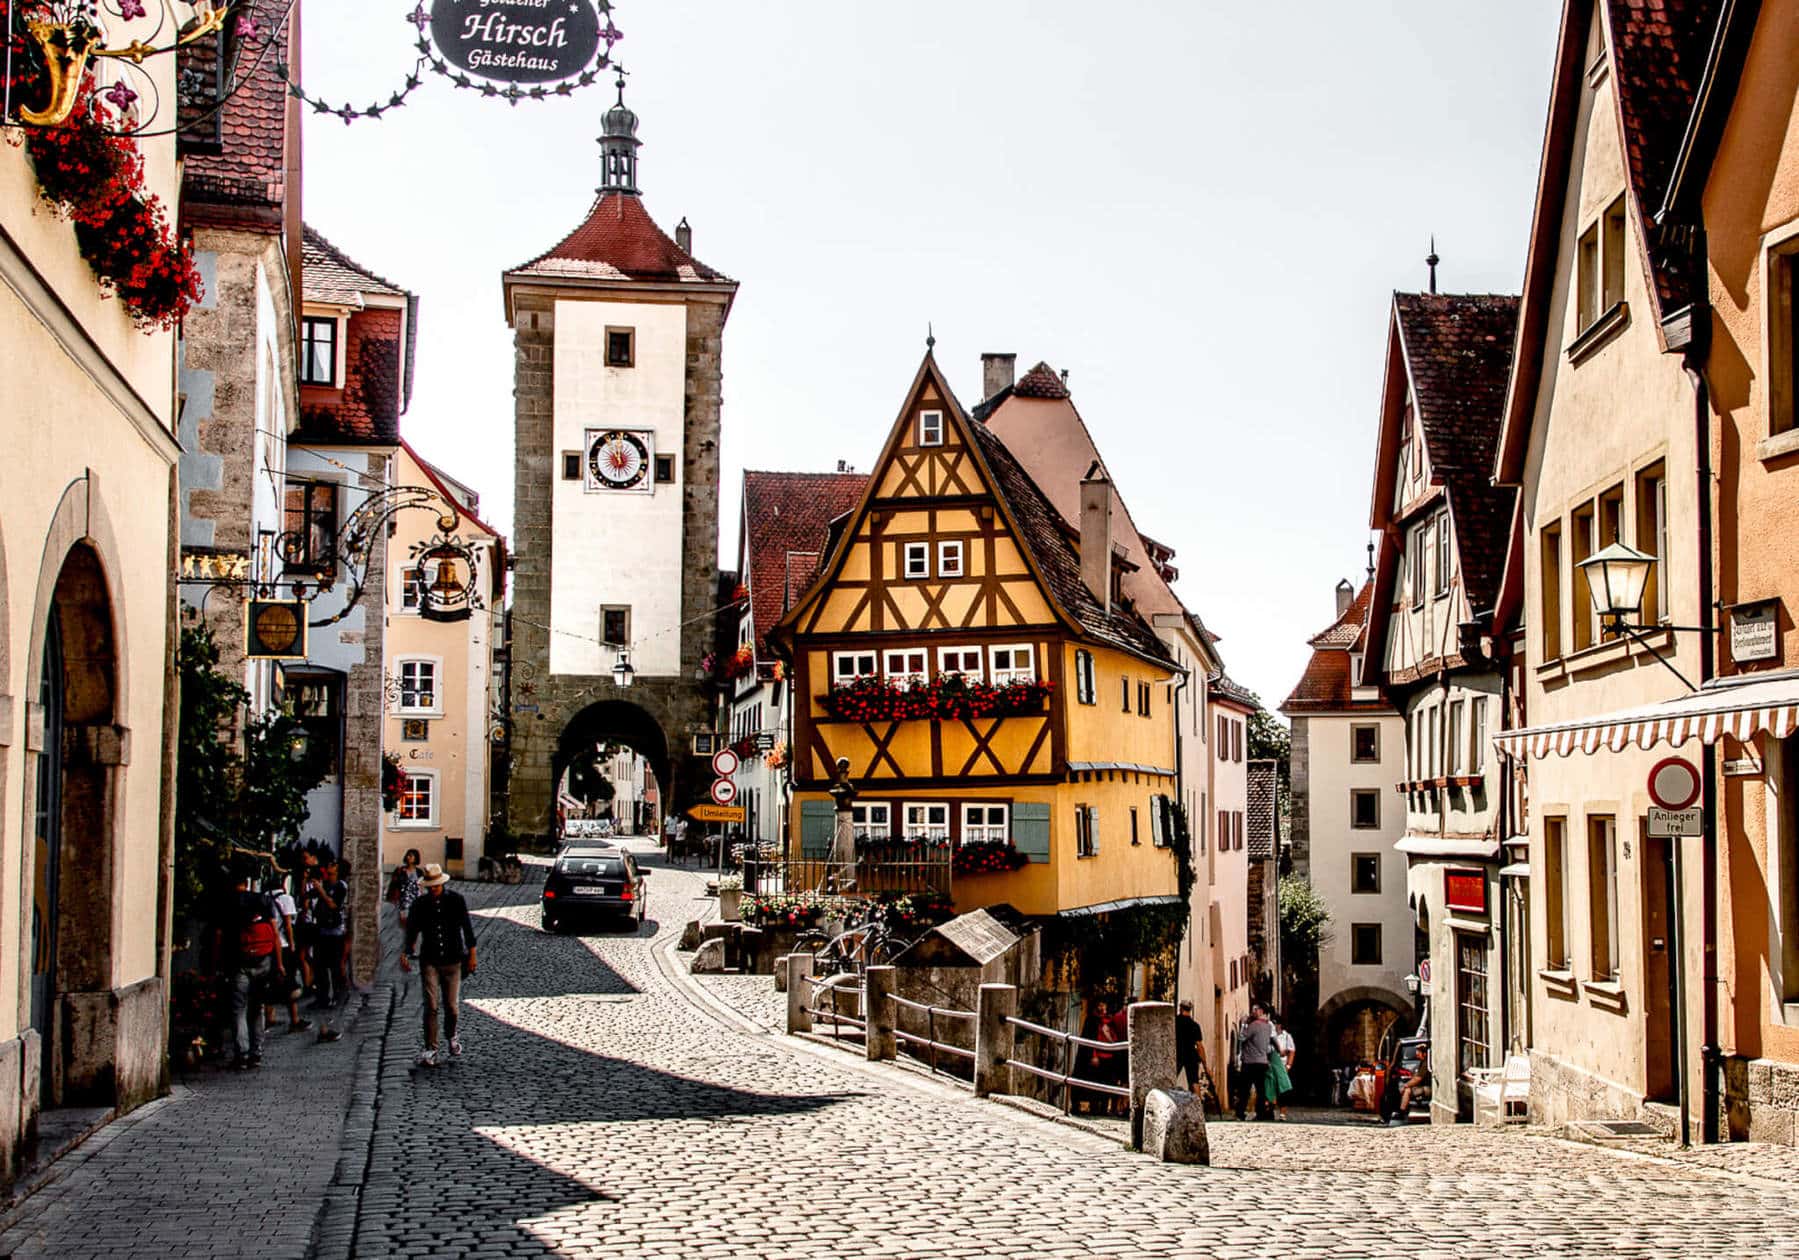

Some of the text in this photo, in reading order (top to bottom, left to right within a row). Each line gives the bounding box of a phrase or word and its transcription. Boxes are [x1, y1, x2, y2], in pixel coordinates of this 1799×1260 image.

[460, 12, 568, 48] Hirsch
[468, 49, 559, 70] Gästehaus
[703, 808, 743, 820] Umleitung
[1654, 811, 1696, 822] Anlieger
[1666, 822, 1684, 832] frei
